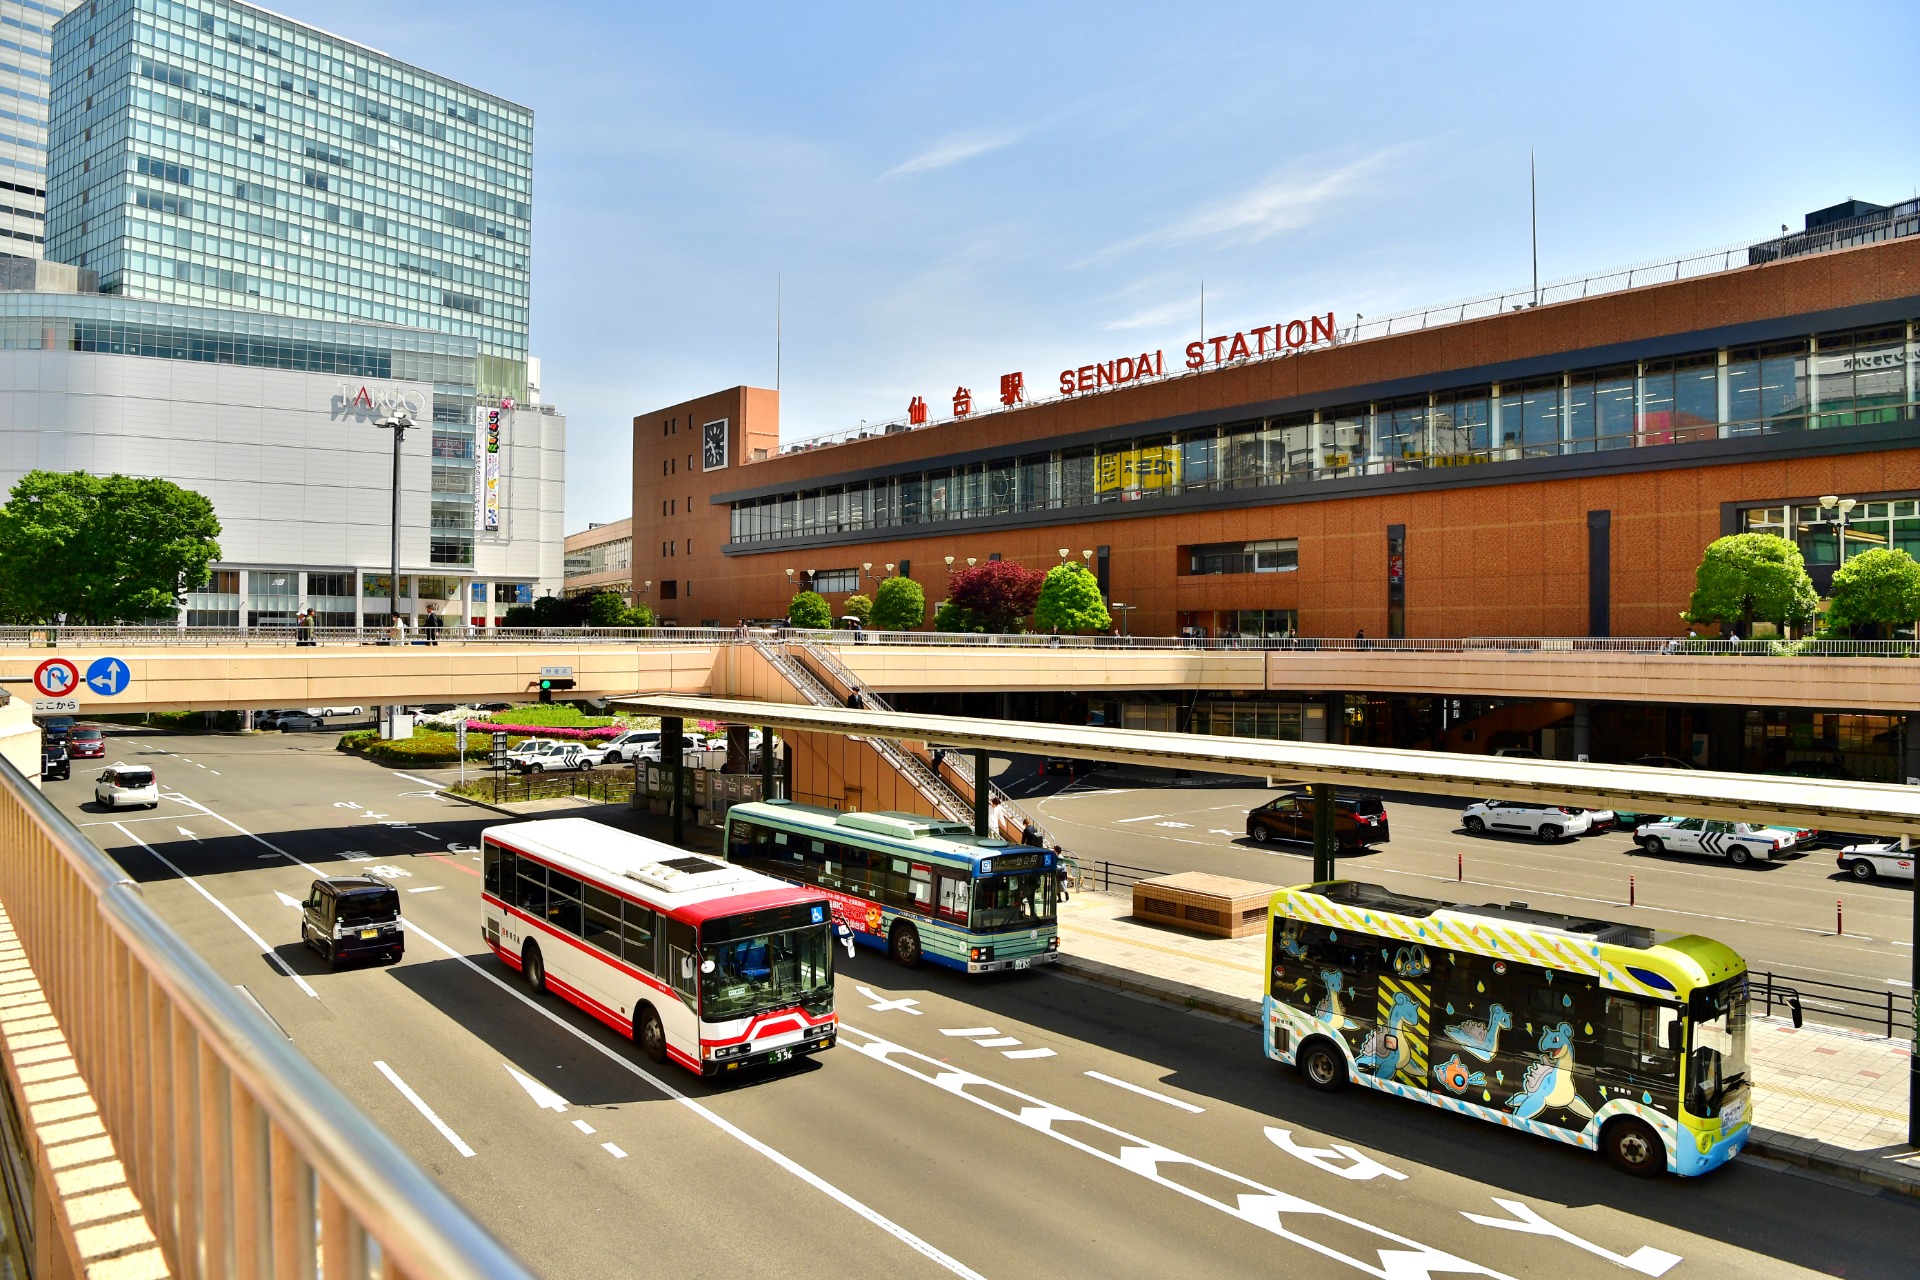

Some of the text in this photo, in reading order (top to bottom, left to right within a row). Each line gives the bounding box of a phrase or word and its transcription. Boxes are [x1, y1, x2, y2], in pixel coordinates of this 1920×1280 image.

[907, 312, 1334, 424] 仙台駅 SENDAI STATION
[342, 384, 426, 412] PARCO
[35, 701, 76, 710] ここから
[777, 1050, 792, 1062] 996
